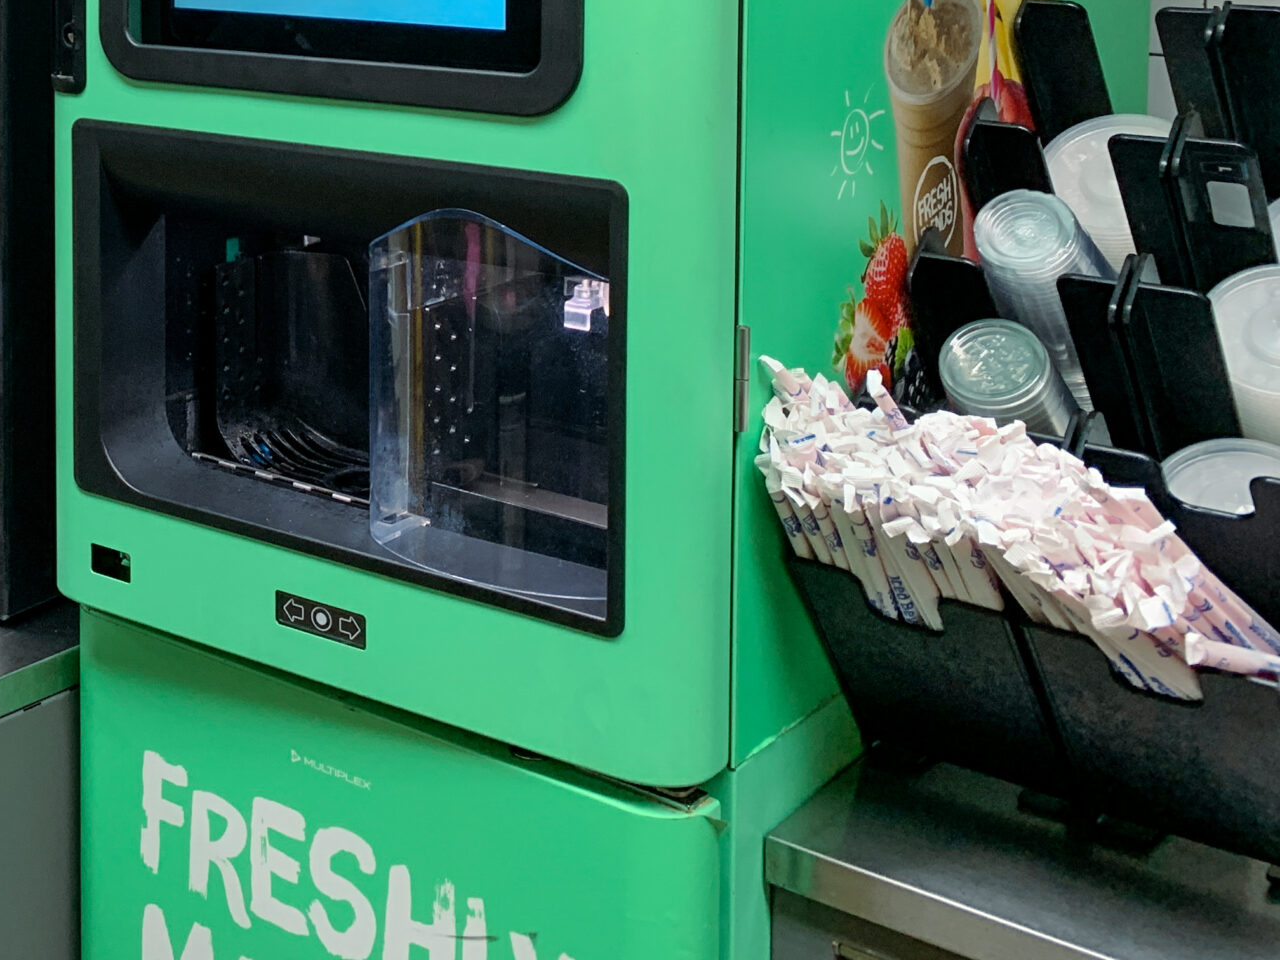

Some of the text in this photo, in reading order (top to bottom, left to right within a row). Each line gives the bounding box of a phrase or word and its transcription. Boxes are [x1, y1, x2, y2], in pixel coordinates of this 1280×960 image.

[918, 174, 951, 227] FRESH
[303, 756, 373, 791] MULTIPLEX
[140, 750, 577, 960] FRESH
